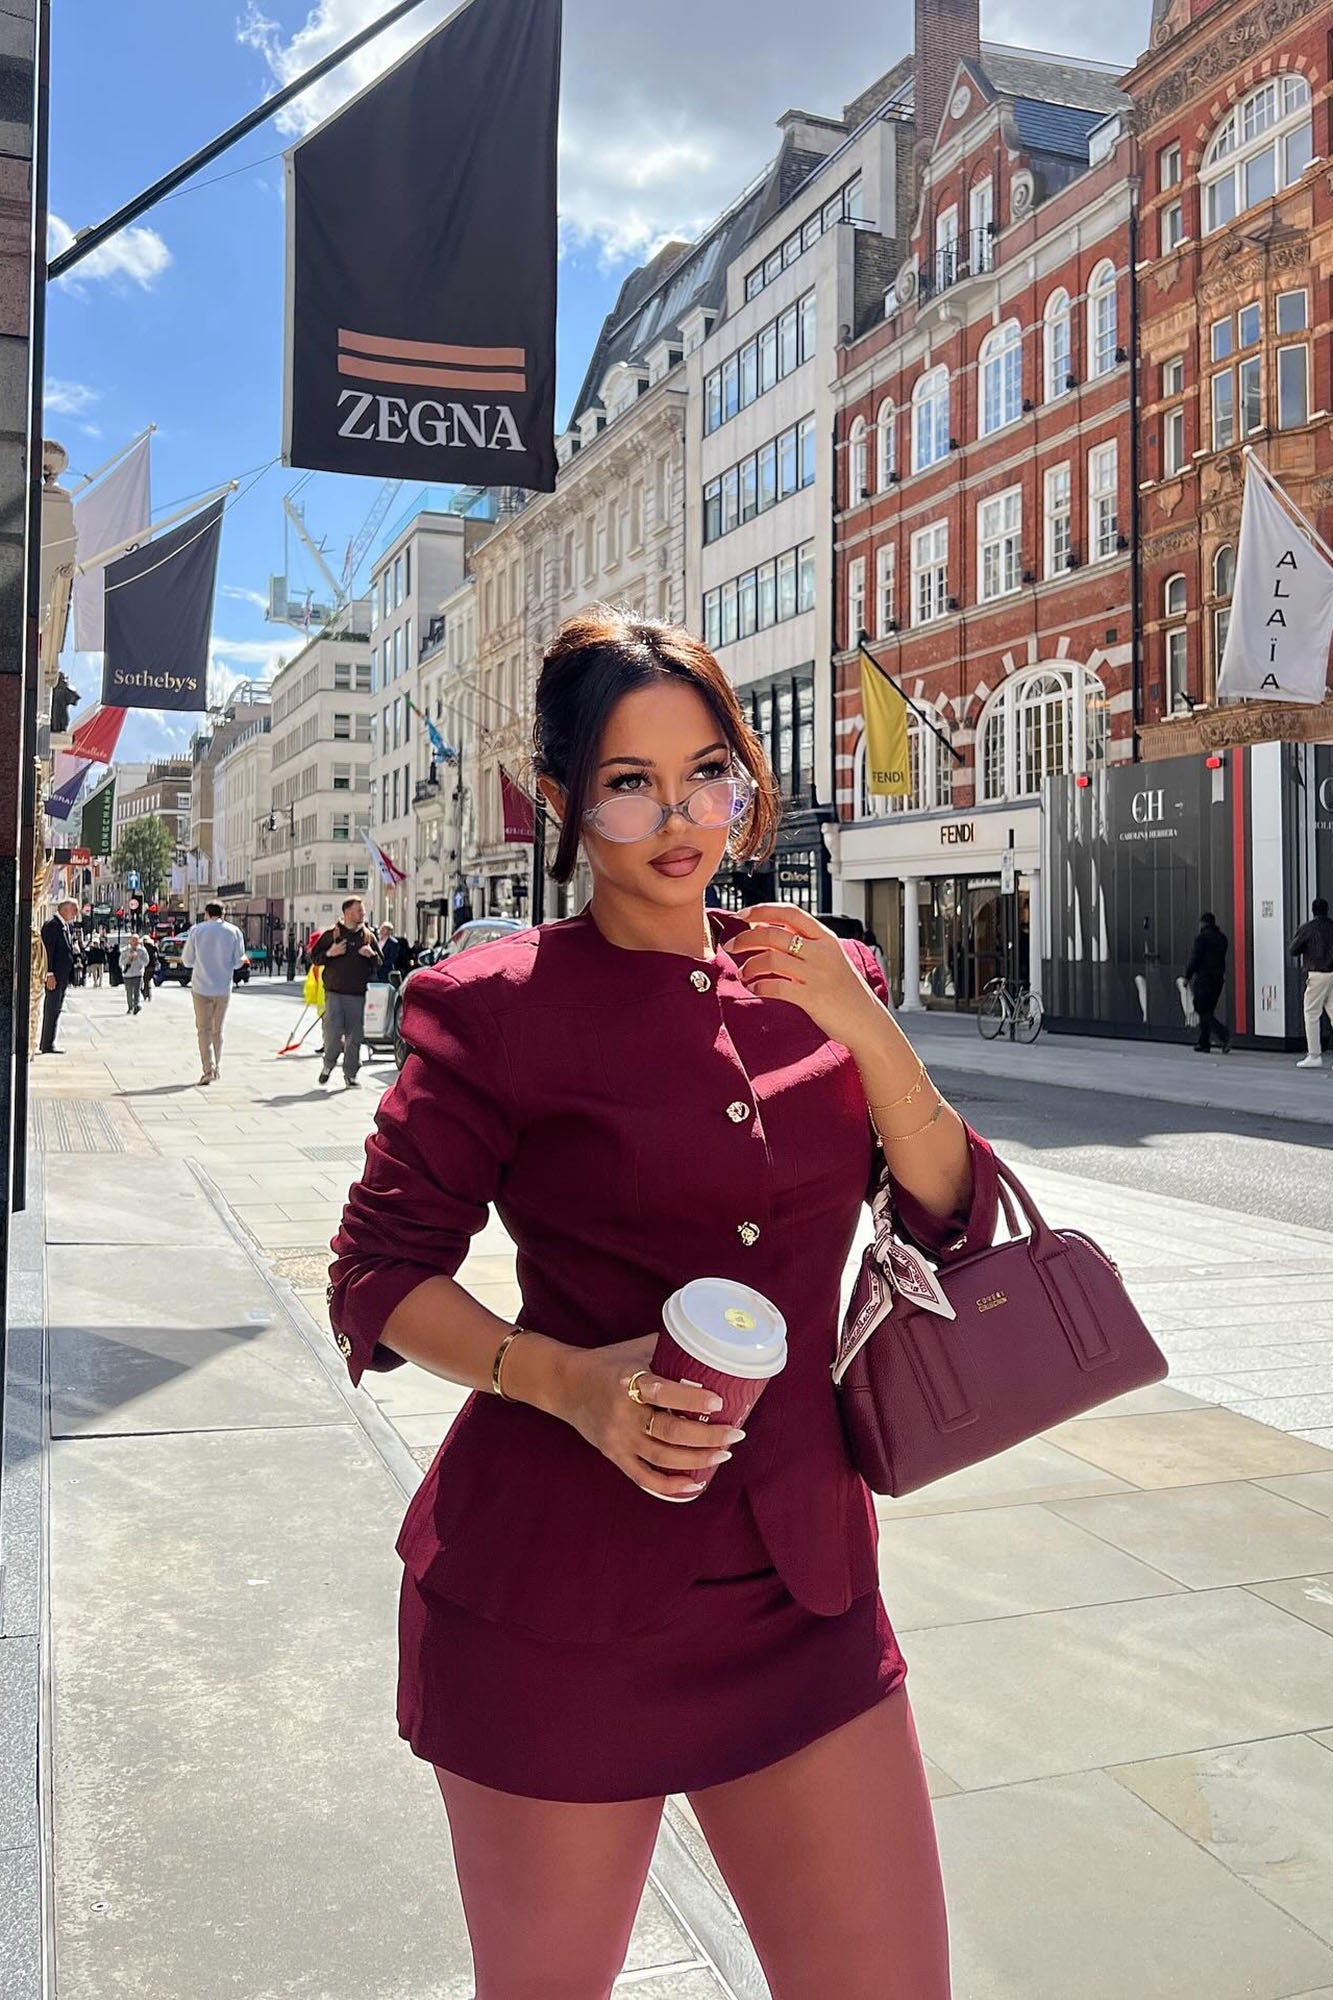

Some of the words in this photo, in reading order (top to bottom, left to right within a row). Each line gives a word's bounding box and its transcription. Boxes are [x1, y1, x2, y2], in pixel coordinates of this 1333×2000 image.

[337, 389, 527, 451] ZEGNA
[113, 669, 197, 692] Sotheby's
[872, 771, 905, 784] FENDI
[1132, 789, 1165, 823] CH
[941, 823, 974, 844] FENDI
